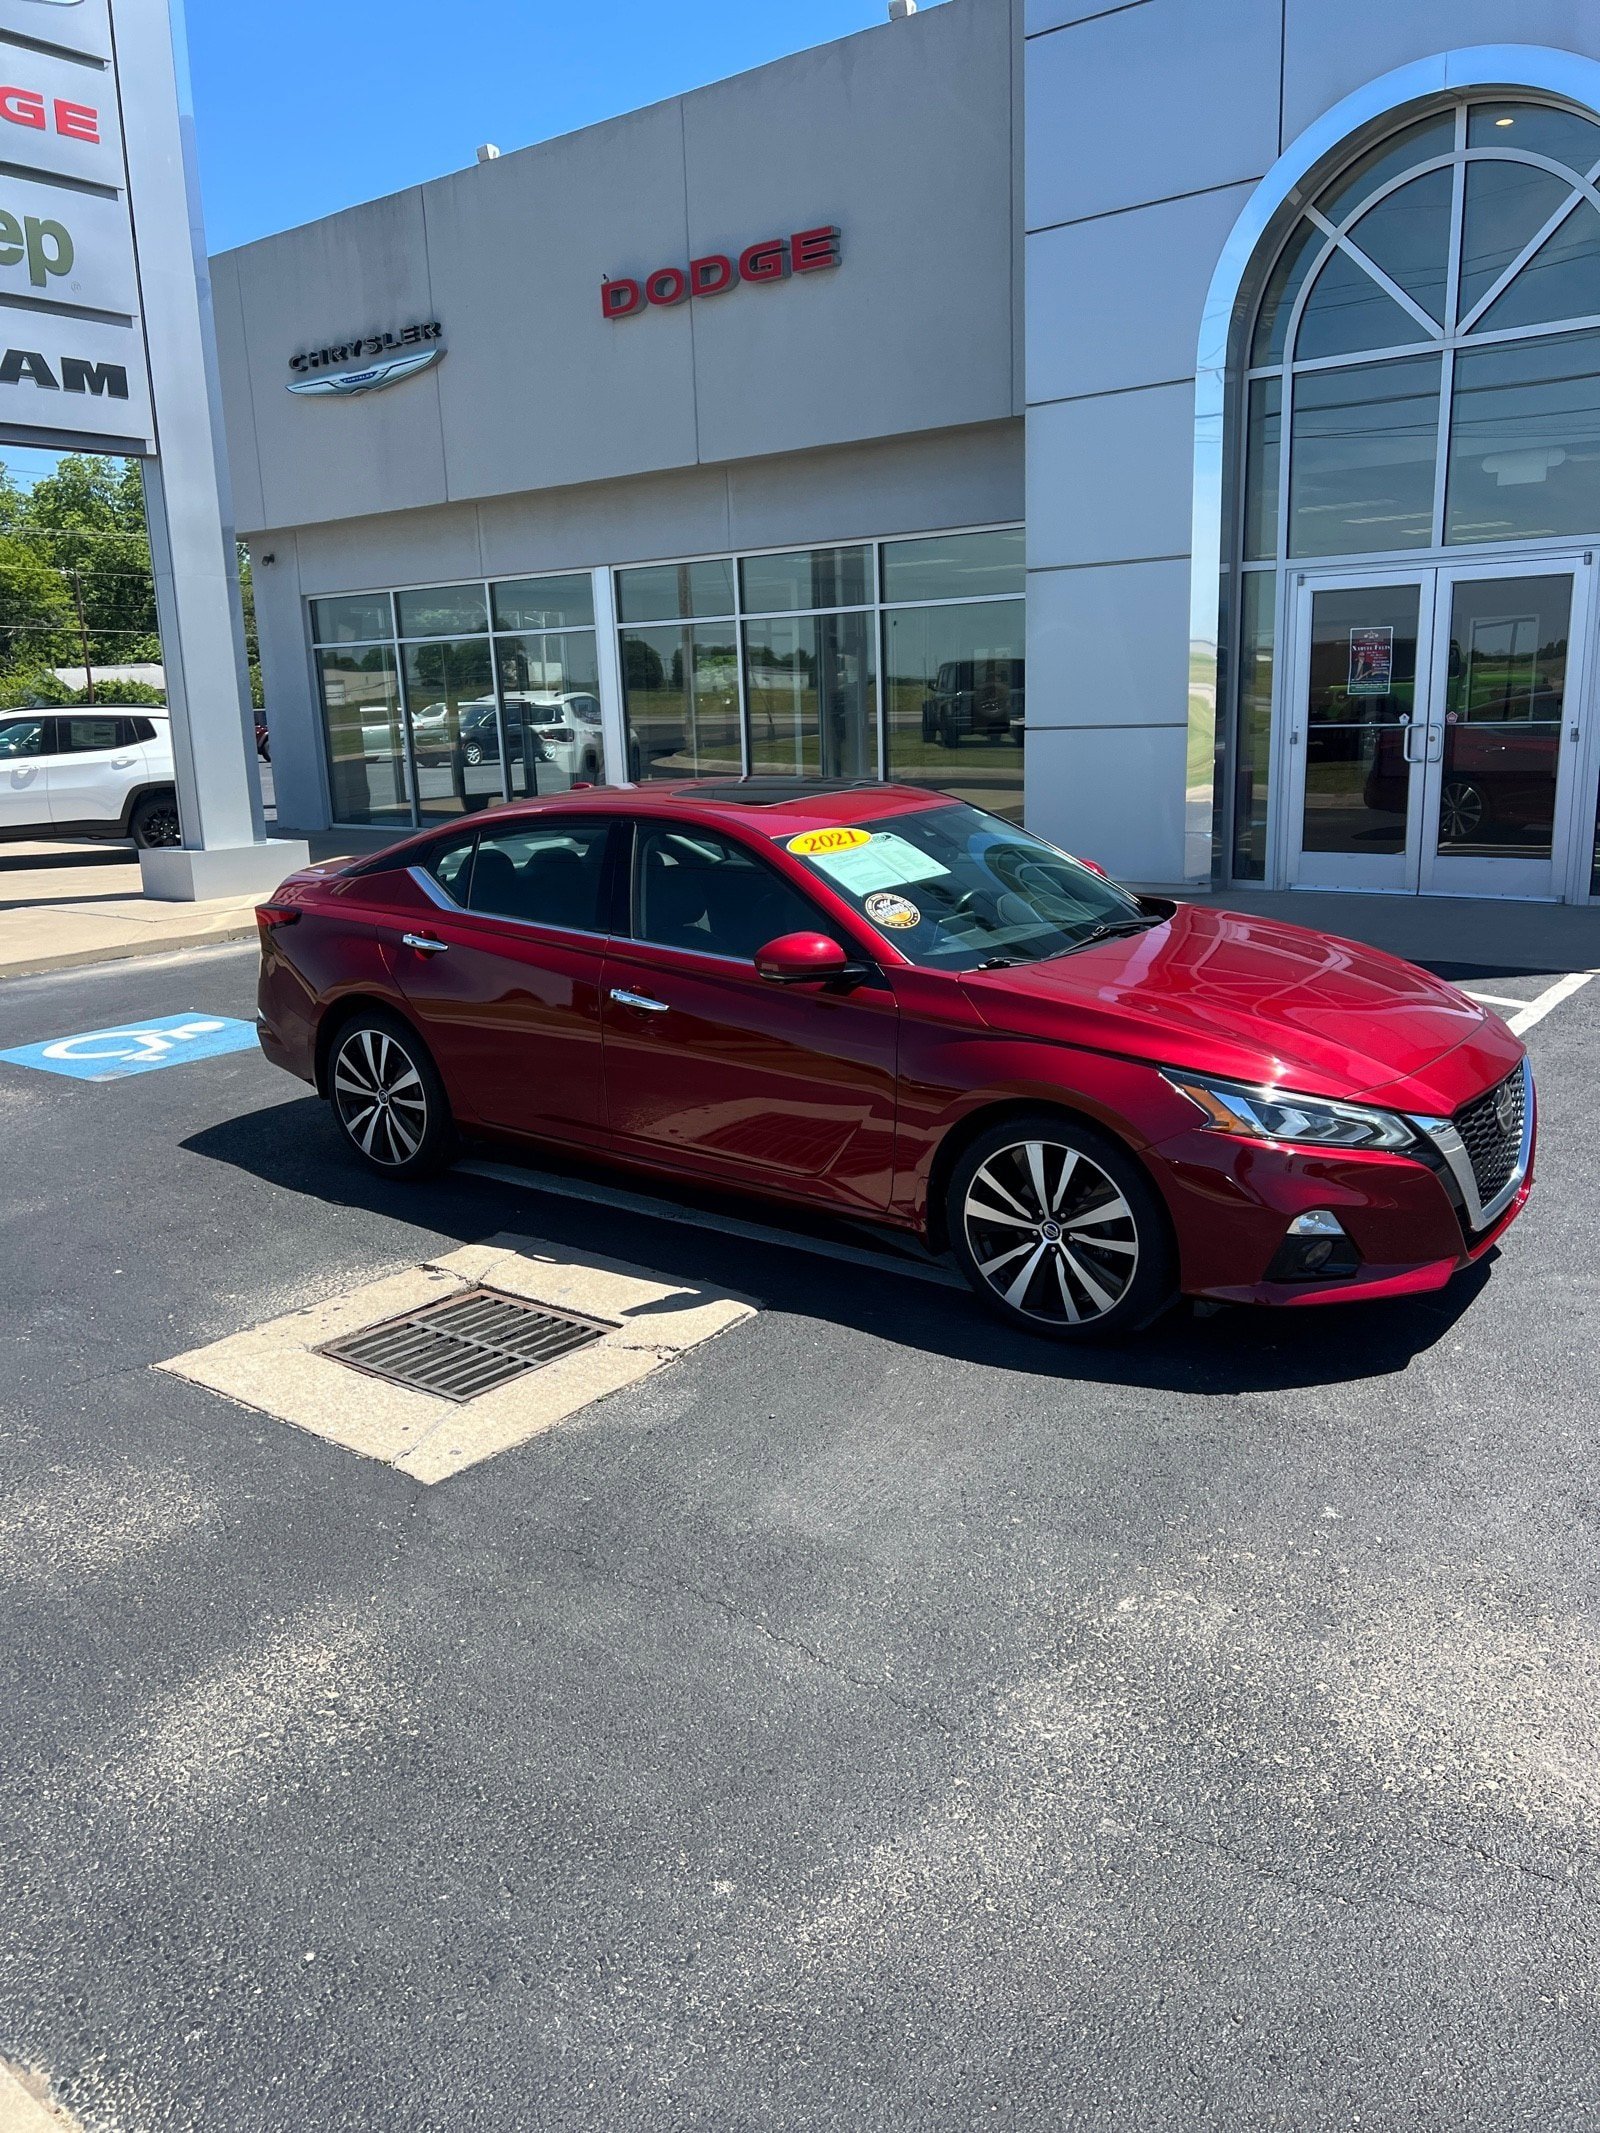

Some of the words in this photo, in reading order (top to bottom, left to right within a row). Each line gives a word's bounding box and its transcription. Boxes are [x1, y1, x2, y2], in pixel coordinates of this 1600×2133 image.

[601, 226, 841, 319] DODGE
[289, 321, 442, 371] CHRYSLER
[0, 348, 129, 400] AM
[804, 830, 859, 852] 2021
